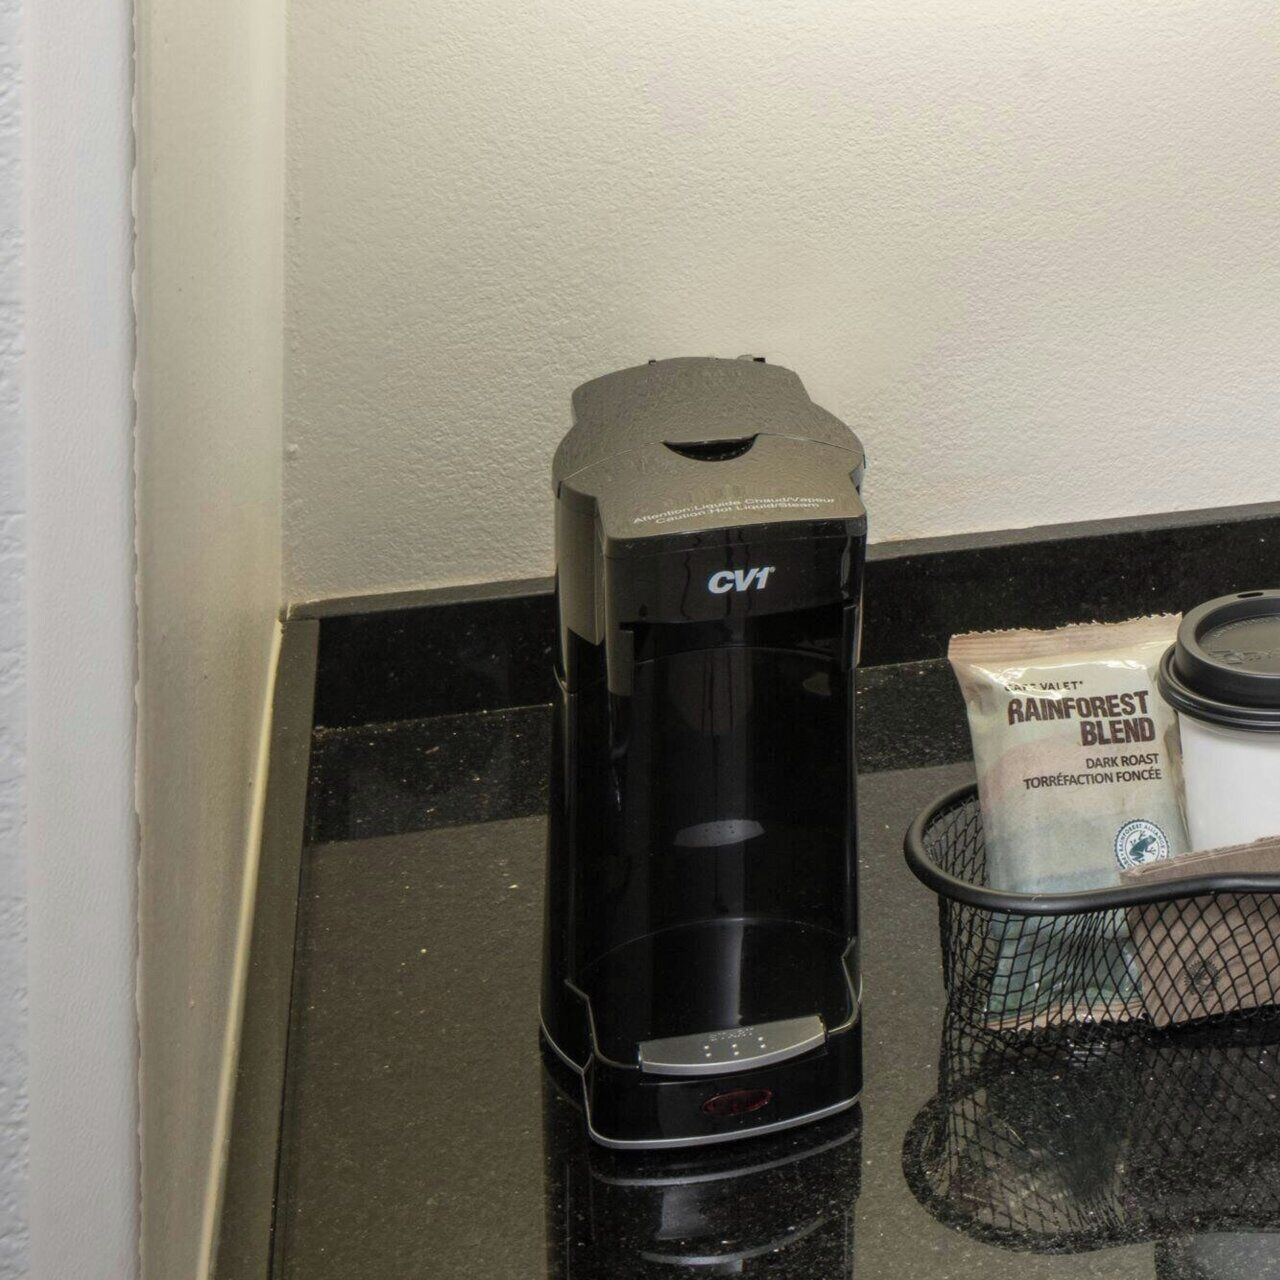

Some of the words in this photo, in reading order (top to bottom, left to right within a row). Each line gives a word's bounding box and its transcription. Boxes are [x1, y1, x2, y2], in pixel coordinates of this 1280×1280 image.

[708, 566, 771, 594] CV1
[1007, 690, 1149, 726] RAINFOREST
[1080, 717, 1156, 747] BLEND
[1085, 756, 1119, 770] DARK
[1121, 753, 1159, 767] ROAST
[1023, 772, 1114, 790] TORRÉFACTION
[1115, 766, 1162, 783] FONCÉE
